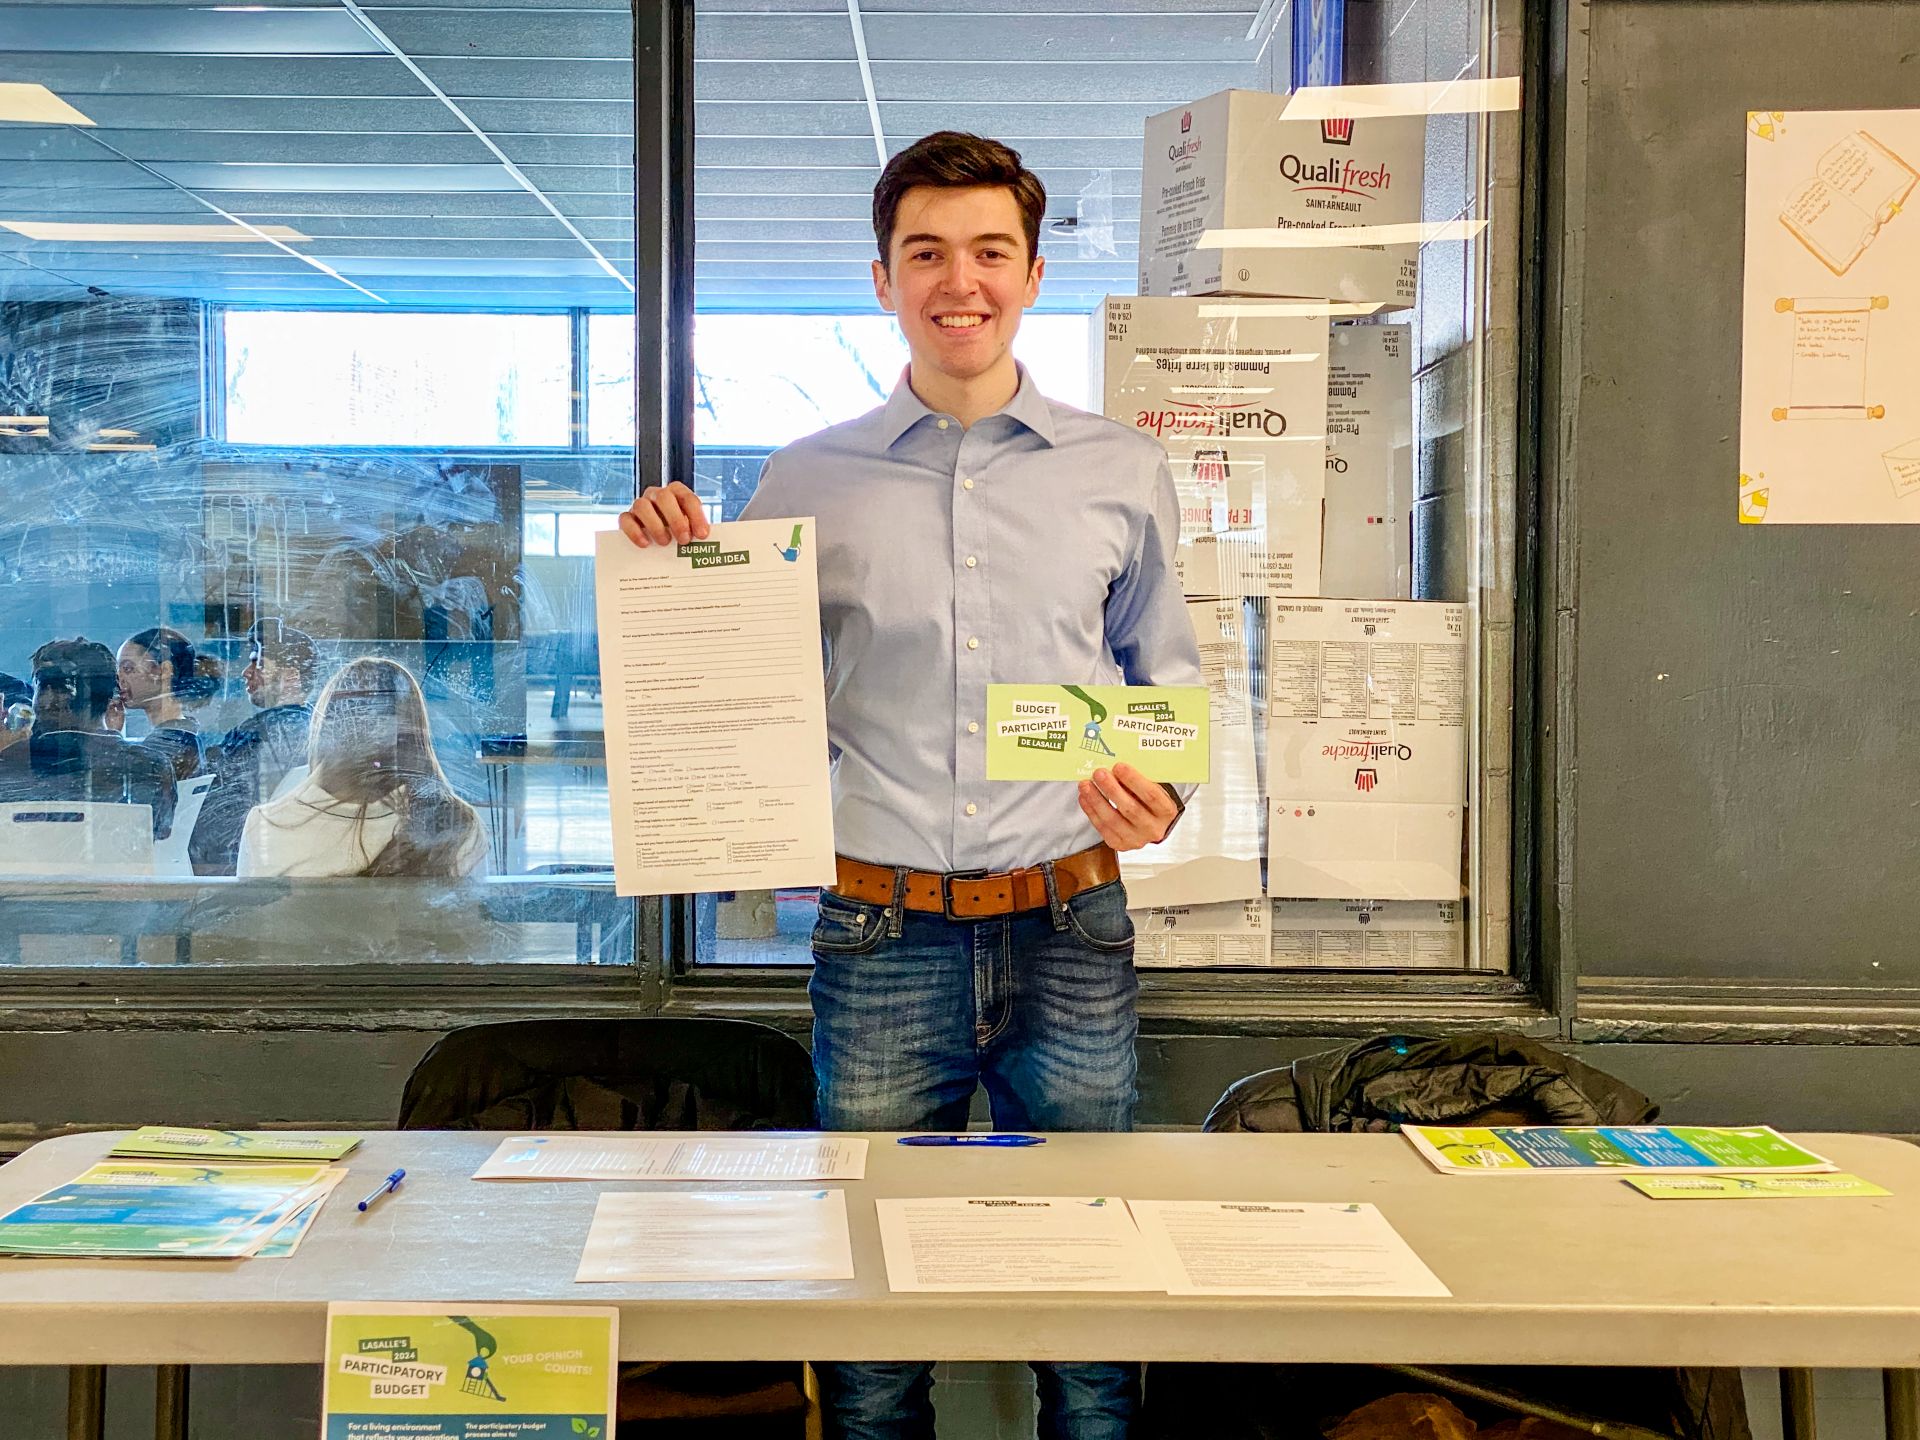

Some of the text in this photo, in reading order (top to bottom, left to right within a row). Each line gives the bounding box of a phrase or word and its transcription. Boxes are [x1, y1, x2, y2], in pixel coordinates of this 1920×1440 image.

[1169, 136, 1202, 162] Qualifresh
[1279, 154, 1391, 193] Qualifresh
[1305, 198, 1362, 212] SAINT-ARNEAULT
[1400, 266, 1417, 278] 12 kg
[1118, 323, 1127, 333] 12
[1328, 386, 1357, 398] Pomme
[1327, 424, 1360, 435] Pre-cook
[681, 545, 717, 554] SUBMIT
[695, 554, 746, 566] YOUR IDEA
[1015, 704, 1057, 714] BUDGET
[1130, 703, 1166, 712] LASALLE'S
[1001, 719, 1068, 734] PARTICIPATIF
[1117, 719, 1196, 737] PARTICIPATORY
[1048, 732, 1066, 740] 2024
[1021, 739, 1062, 750] DE LASALLE
[1141, 738, 1182, 748] BUDGET
[1321, 741, 1412, 762] Qualifraîche
[362, 1339, 407, 1350] LASALLE'S
[394, 1352, 416, 1361] 2024
[503, 1350, 583, 1366] YOUR OPINION
[344, 1360, 443, 1382] PARTICIPATORY
[544, 1363, 593, 1376] COUNTS!
[374, 1384, 426, 1395] BUDGET
[348, 1423, 361, 1431] For
[369, 1423, 390, 1432] living
[391, 1423, 442, 1431] environment
[478, 1422, 521, 1431] participatory
[522, 1422, 546, 1431] budget
